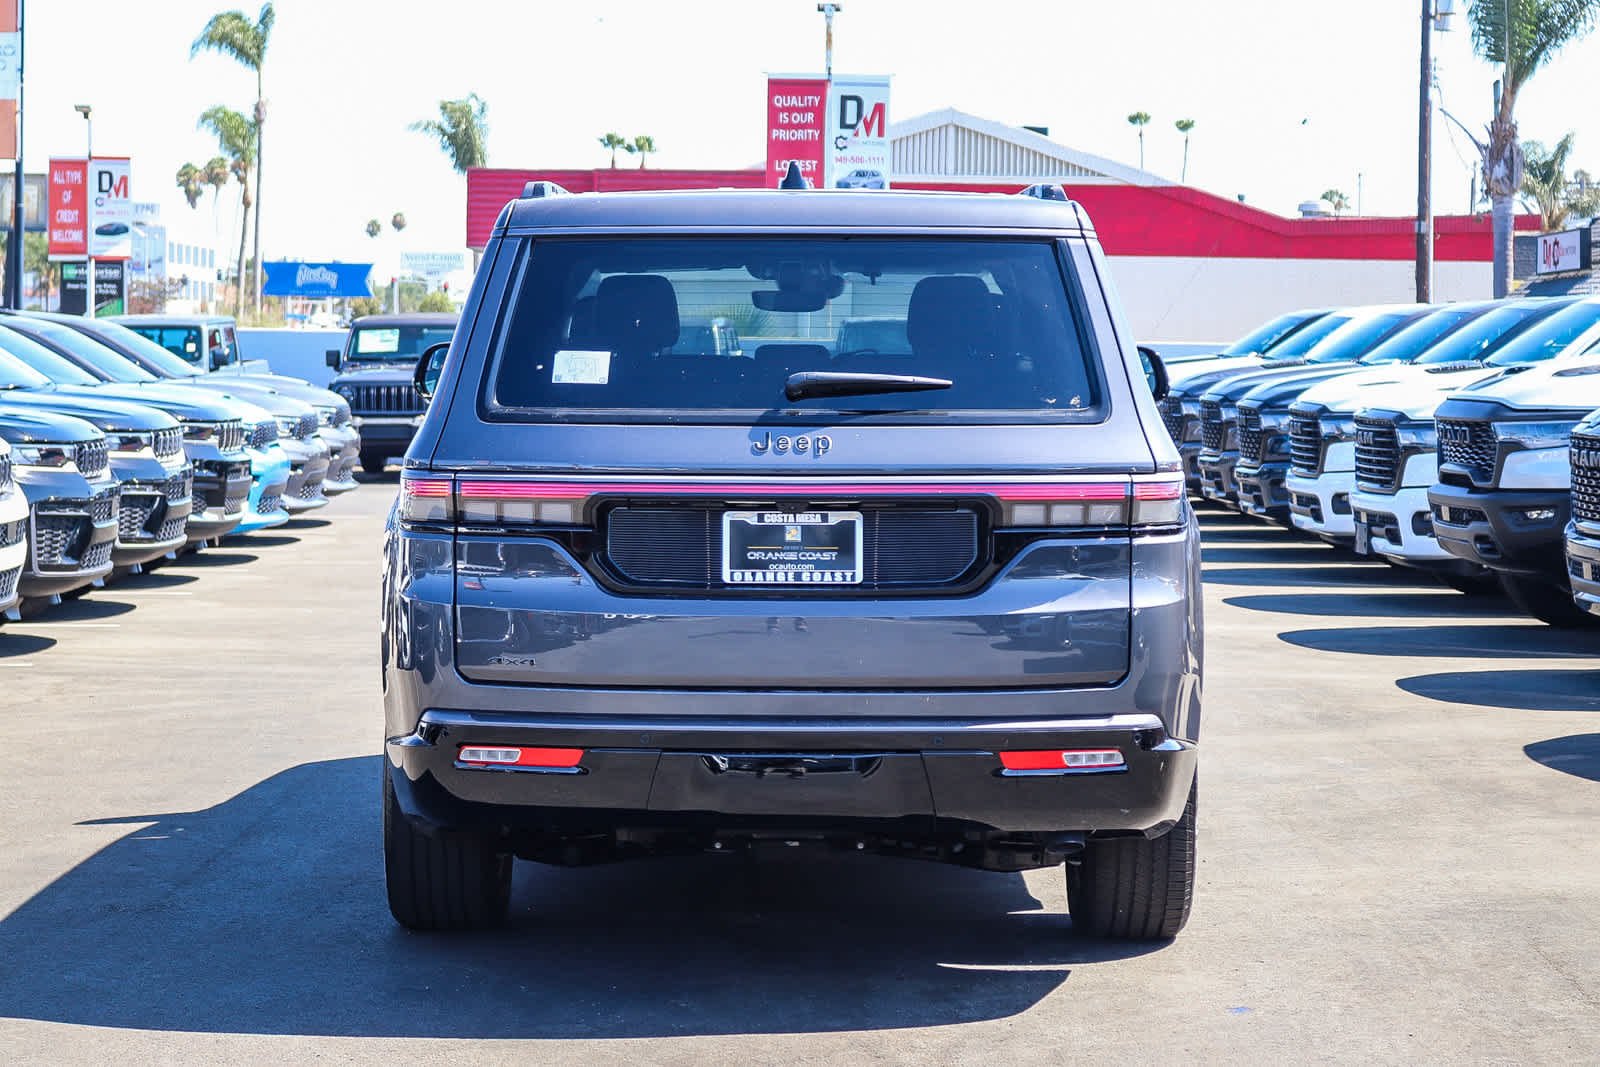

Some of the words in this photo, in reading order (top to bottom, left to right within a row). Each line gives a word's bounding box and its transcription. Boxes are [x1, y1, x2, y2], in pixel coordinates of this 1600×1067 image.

[774, 95, 820, 107] QUALITY
[780, 112, 789, 123] IS
[791, 112, 815, 123] OUR
[772, 129, 820, 141] PRIORITY
[775, 160, 818, 171] LOEST
[54, 170, 65, 184] ALL
[66, 170, 83, 185] TYPE
[62, 190, 72, 203] OF
[56, 209, 79, 224] CREDIT
[52, 229, 84, 243] WELCOME
[752, 431, 833, 456] Jeep
[763, 513, 795, 523] COSTA
[796, 513, 822, 523] MESA
[747, 551, 798, 560] ORANGE
[799, 551, 838, 561] COAST
[768, 562, 815, 571] ocauto.com
[733, 572, 796, 582] ORANGE
[802, 572, 854, 582] COAST
